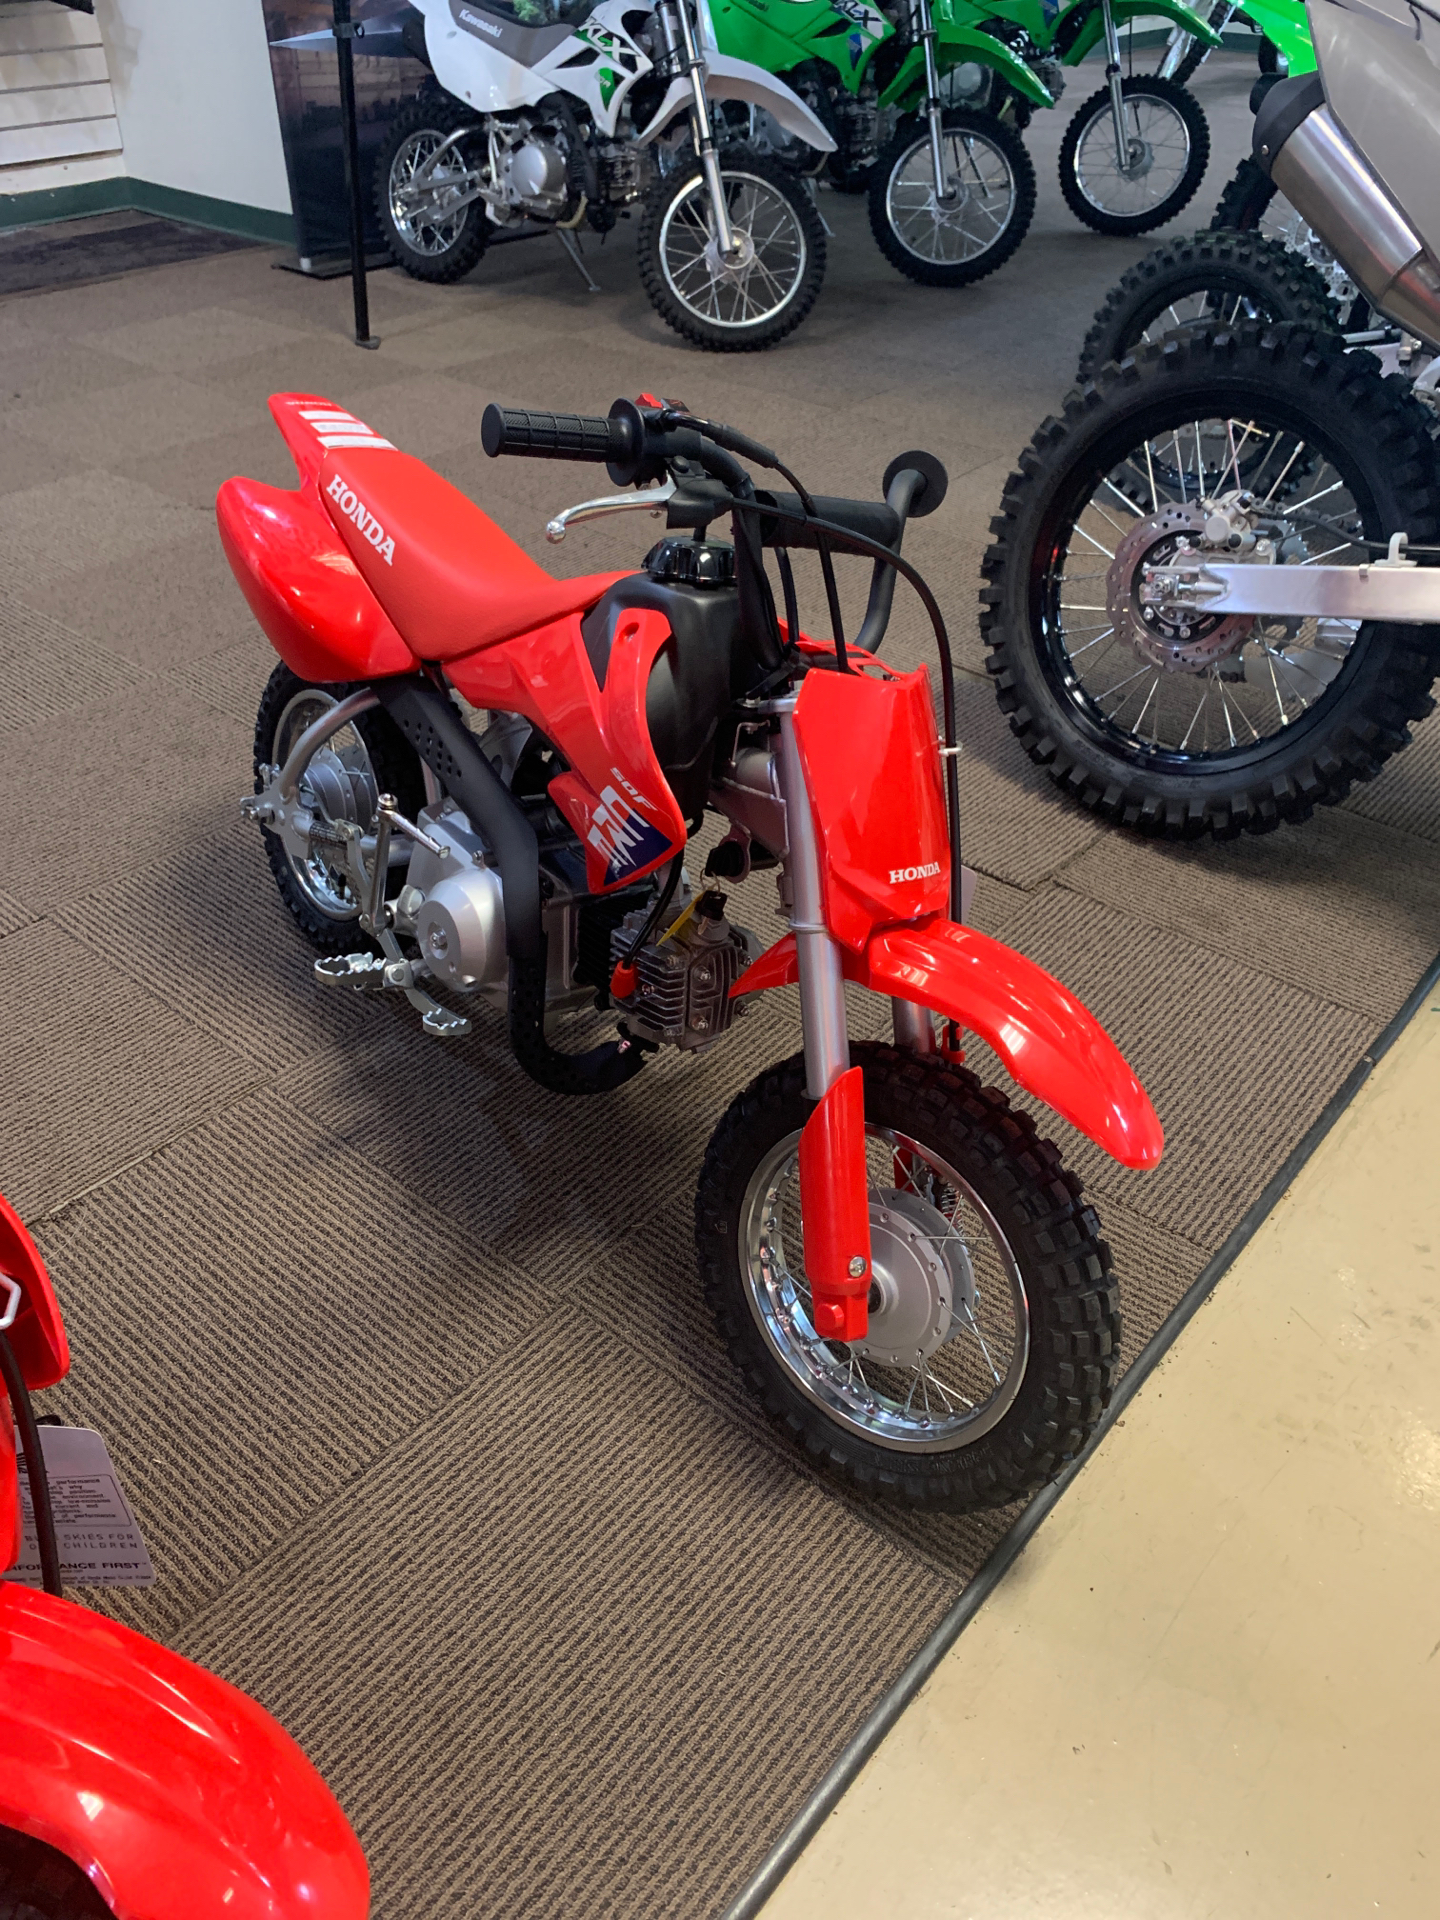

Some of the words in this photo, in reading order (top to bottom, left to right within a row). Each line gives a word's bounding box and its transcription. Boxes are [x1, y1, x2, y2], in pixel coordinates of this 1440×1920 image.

[458, 9, 503, 38] Kawasaki
[578, 16, 642, 64] KLX
[326, 474, 397, 566] HONDA
[610, 767, 658, 811] 50F
[889, 861, 941, 884] HONDA
[63, 1533, 104, 1541] SKIES
[108, 1533, 134, 1541] FOR
